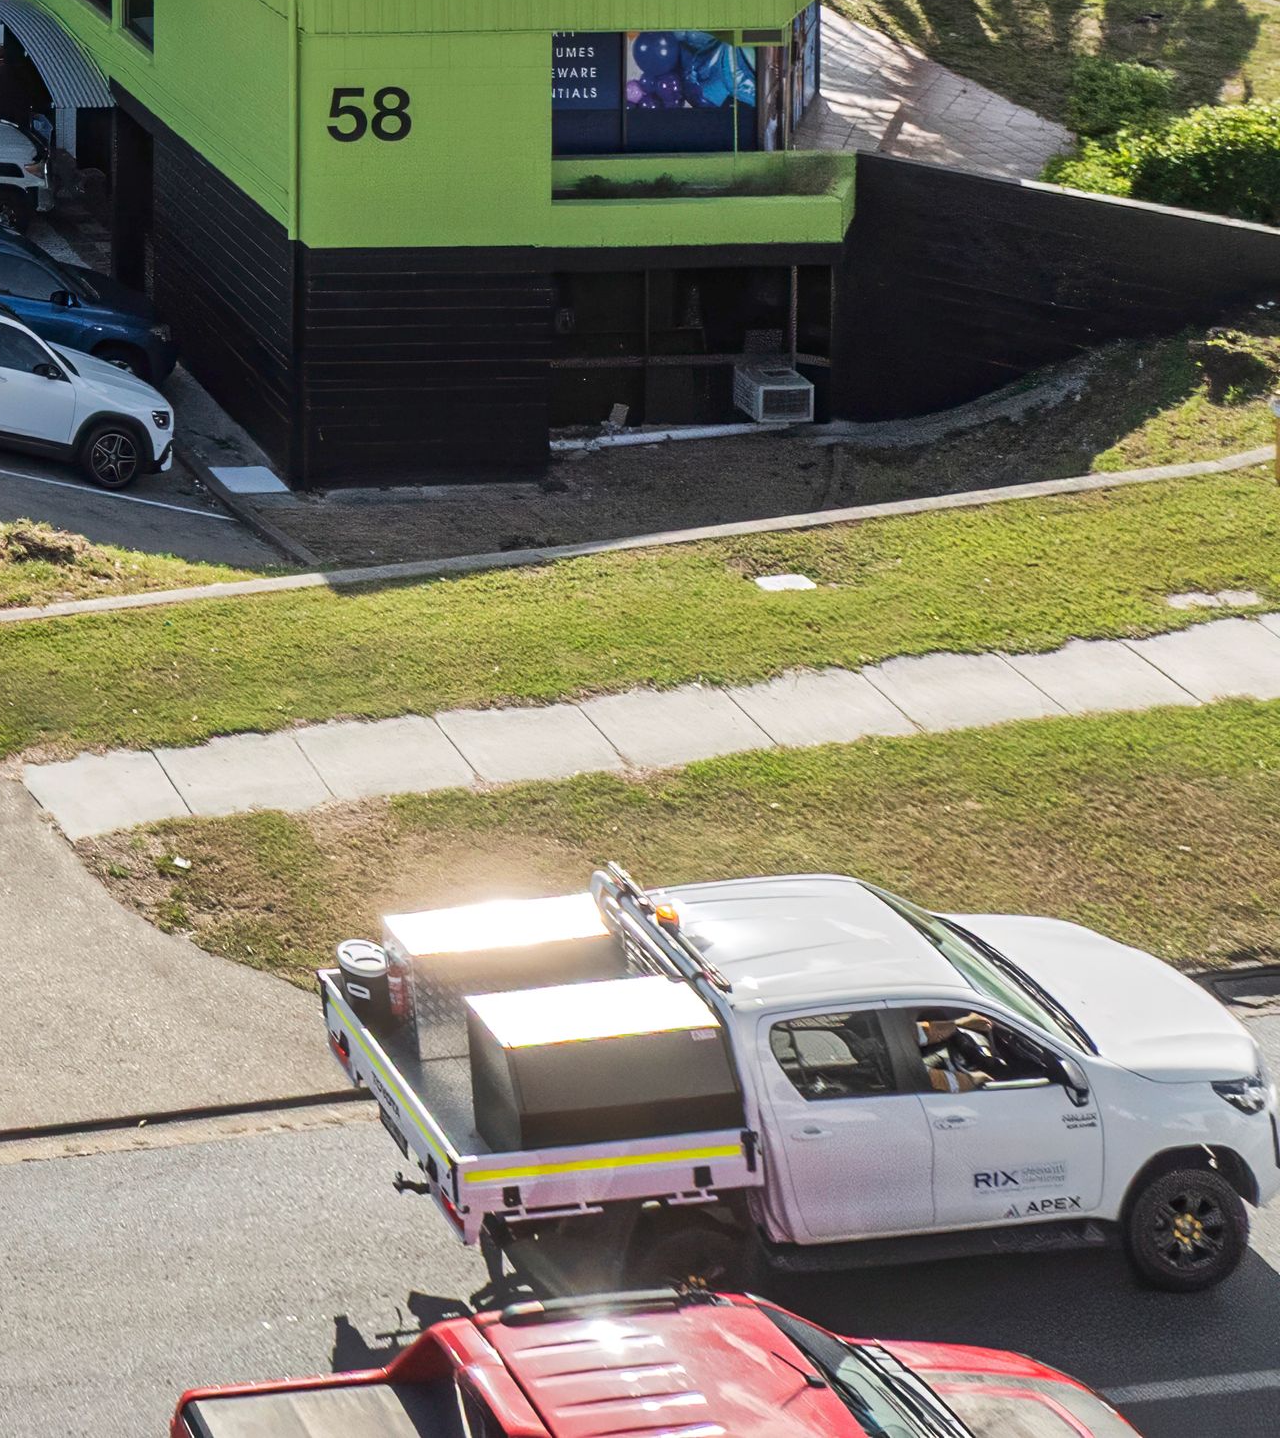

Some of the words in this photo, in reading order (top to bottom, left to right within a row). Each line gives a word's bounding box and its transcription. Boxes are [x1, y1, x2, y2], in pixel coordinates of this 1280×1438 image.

[326, 86, 413, 142] 58
[974, 1170, 1020, 1188] RIX
[1025, 1196, 1082, 1214] APEX
